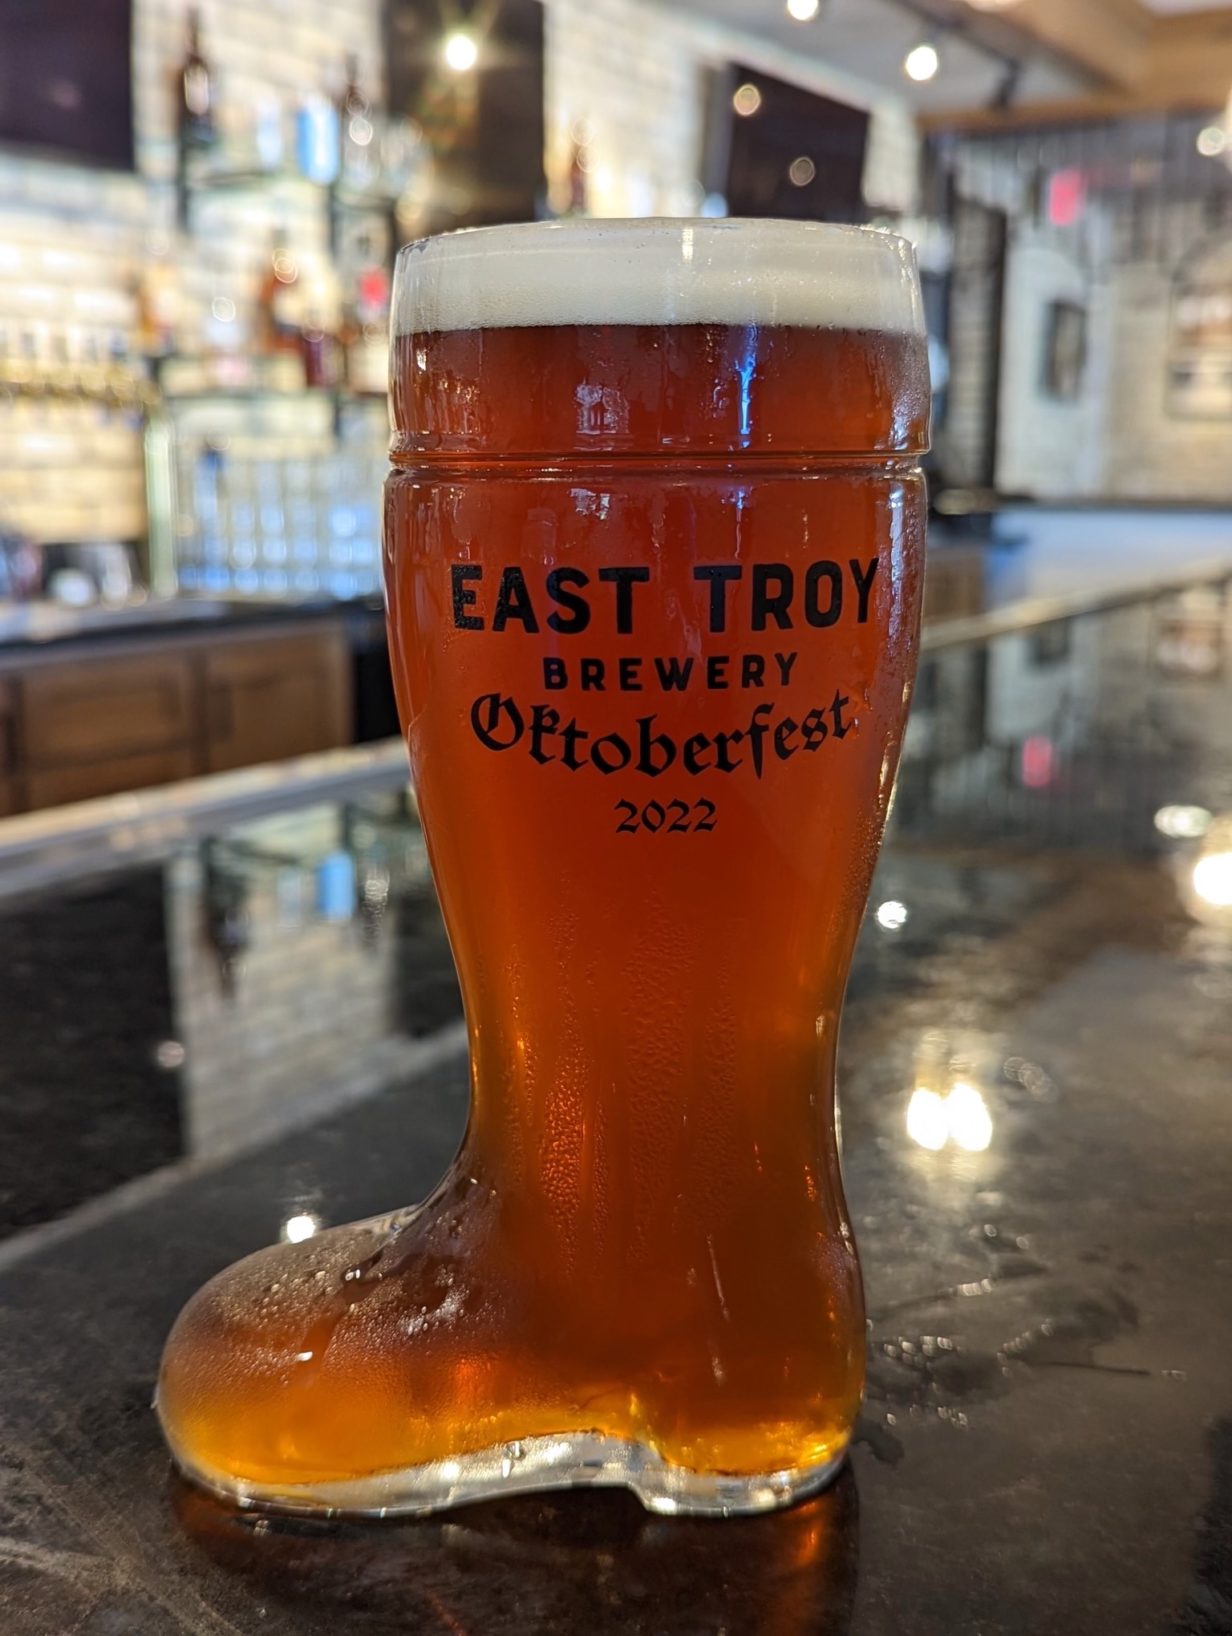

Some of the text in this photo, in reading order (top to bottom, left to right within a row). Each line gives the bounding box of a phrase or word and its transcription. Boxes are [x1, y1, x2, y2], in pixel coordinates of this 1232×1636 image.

[450, 557, 880, 635] EAST TROY
[542, 651, 798, 692] BREWERY
[470, 688, 853, 780] Oktoberfest
[613, 798, 718, 835] 2022
